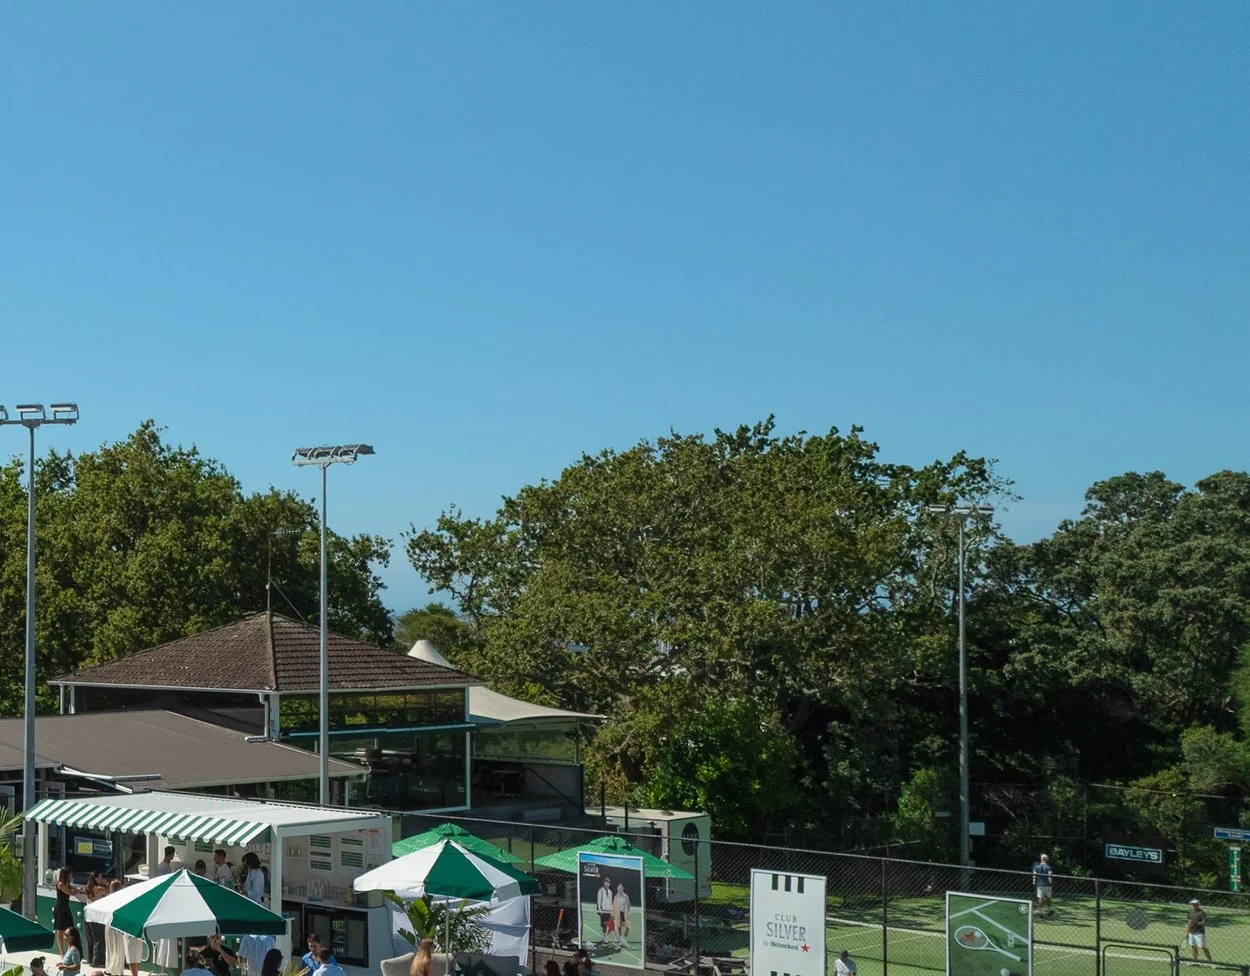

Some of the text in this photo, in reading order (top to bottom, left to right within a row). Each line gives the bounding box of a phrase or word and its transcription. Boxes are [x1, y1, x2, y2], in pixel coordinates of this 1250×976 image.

[1109, 847, 1159, 860] BAYLEYS
[774, 913, 798, 923] CLUB
[766, 921, 807, 942] SILVER
[770, 940, 799, 950] Heineken
